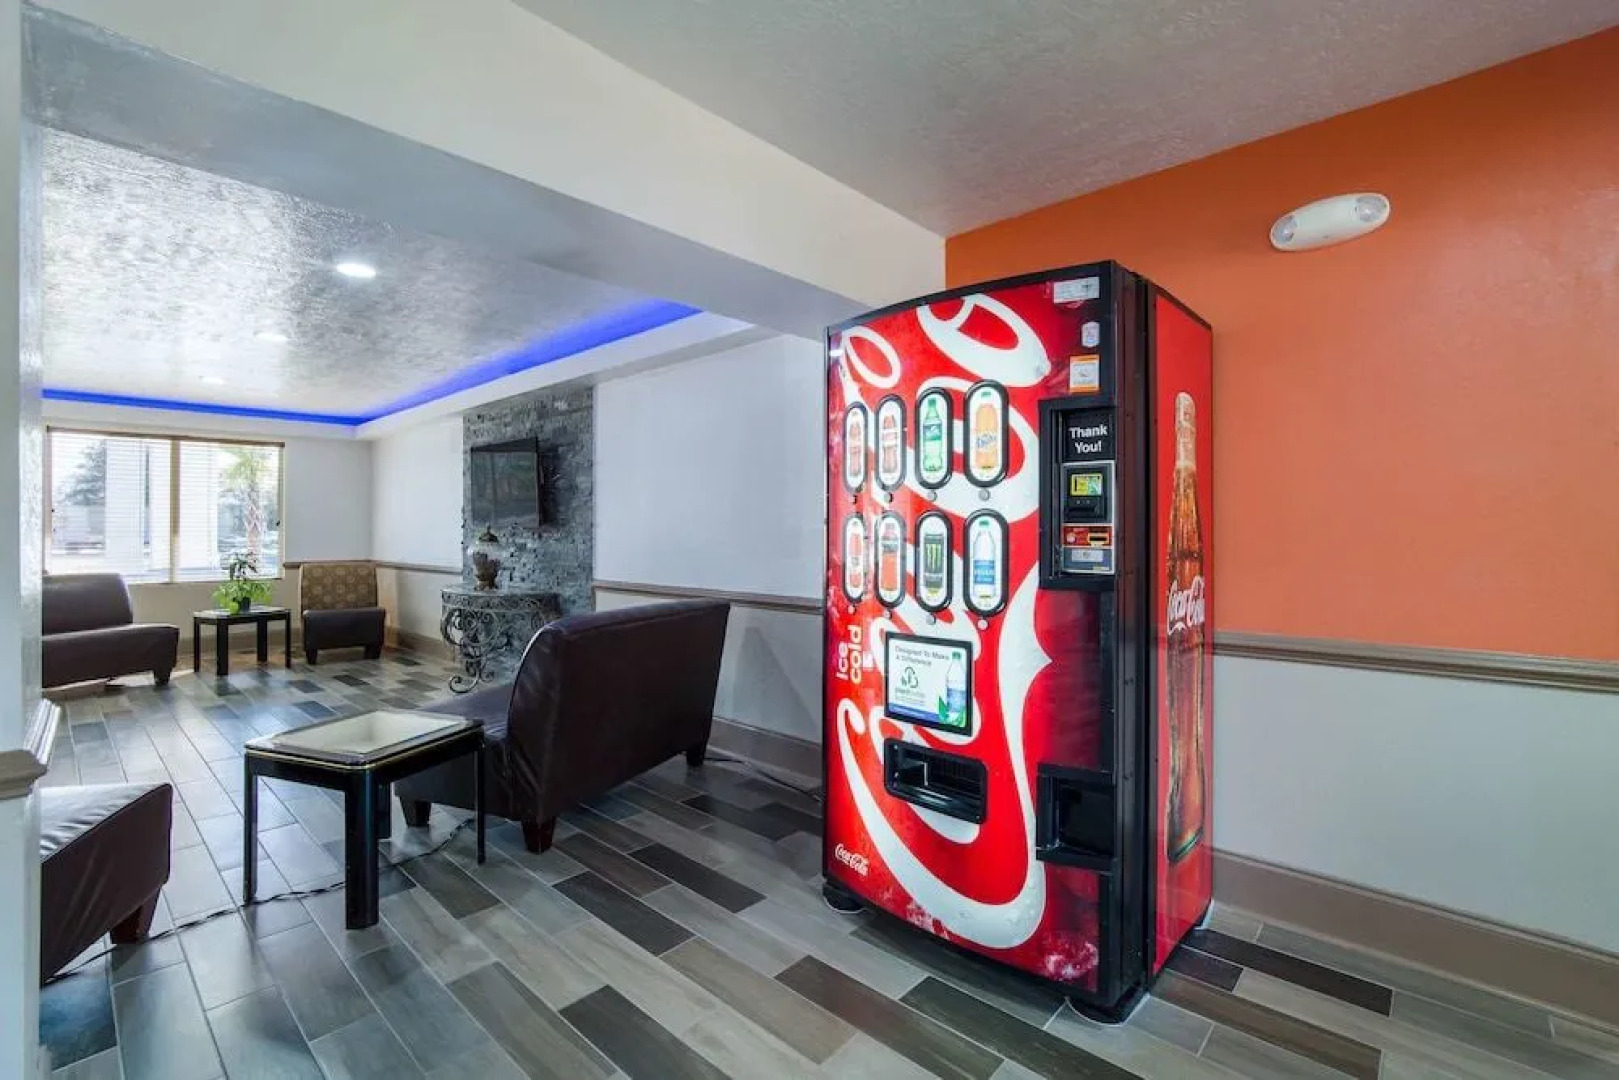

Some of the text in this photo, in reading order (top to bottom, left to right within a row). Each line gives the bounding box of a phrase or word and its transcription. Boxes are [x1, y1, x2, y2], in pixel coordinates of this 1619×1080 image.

[1069, 424, 1108, 439] Thank
[1075, 440, 1102, 454] You!
[836, 641, 849, 681] Ice
[847, 624, 862, 684] cold
